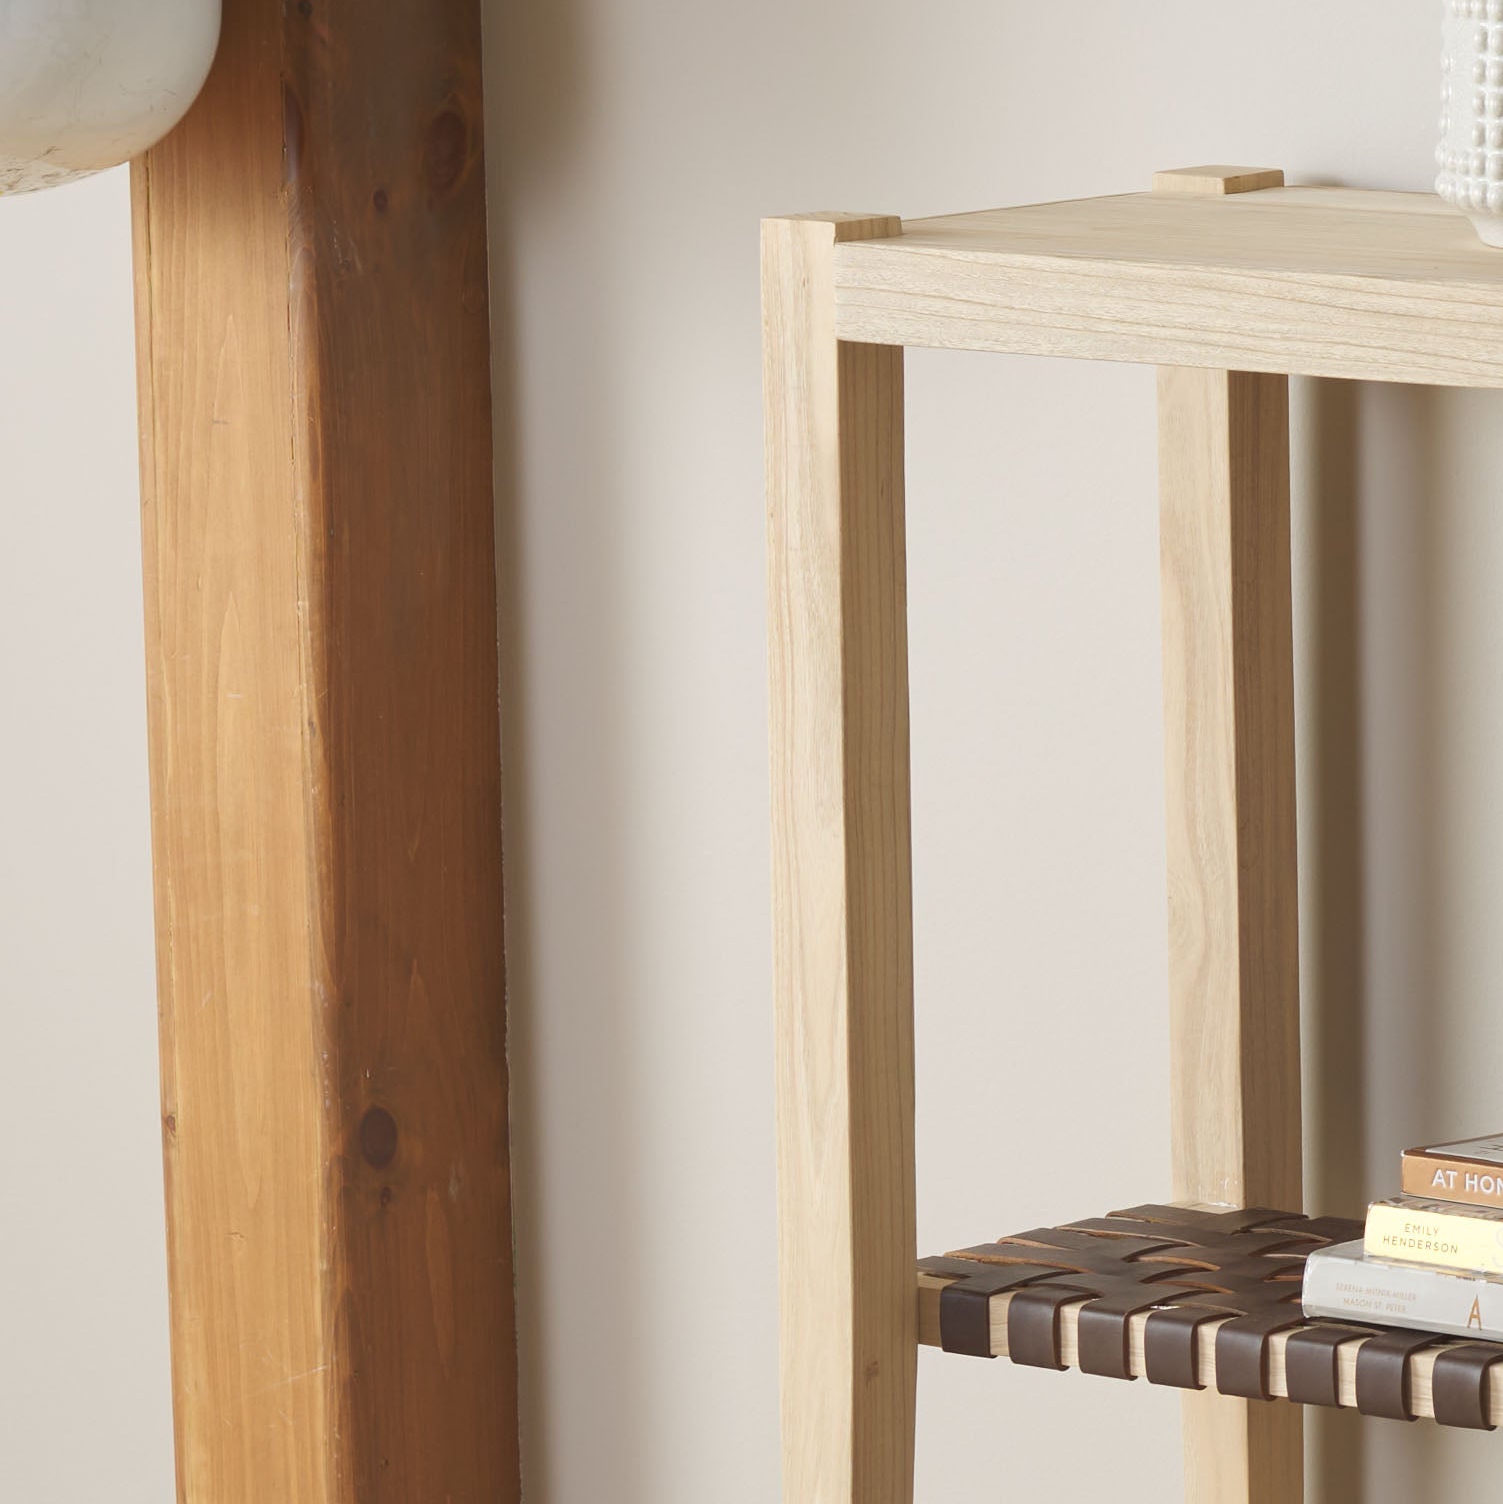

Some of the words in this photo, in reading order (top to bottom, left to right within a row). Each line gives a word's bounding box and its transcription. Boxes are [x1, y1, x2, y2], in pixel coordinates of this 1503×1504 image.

[1431, 1168, 1458, 1189] AT
[1404, 1223, 1439, 1237] EMILY
[1383, 1235, 1458, 1254] HENDERSON
